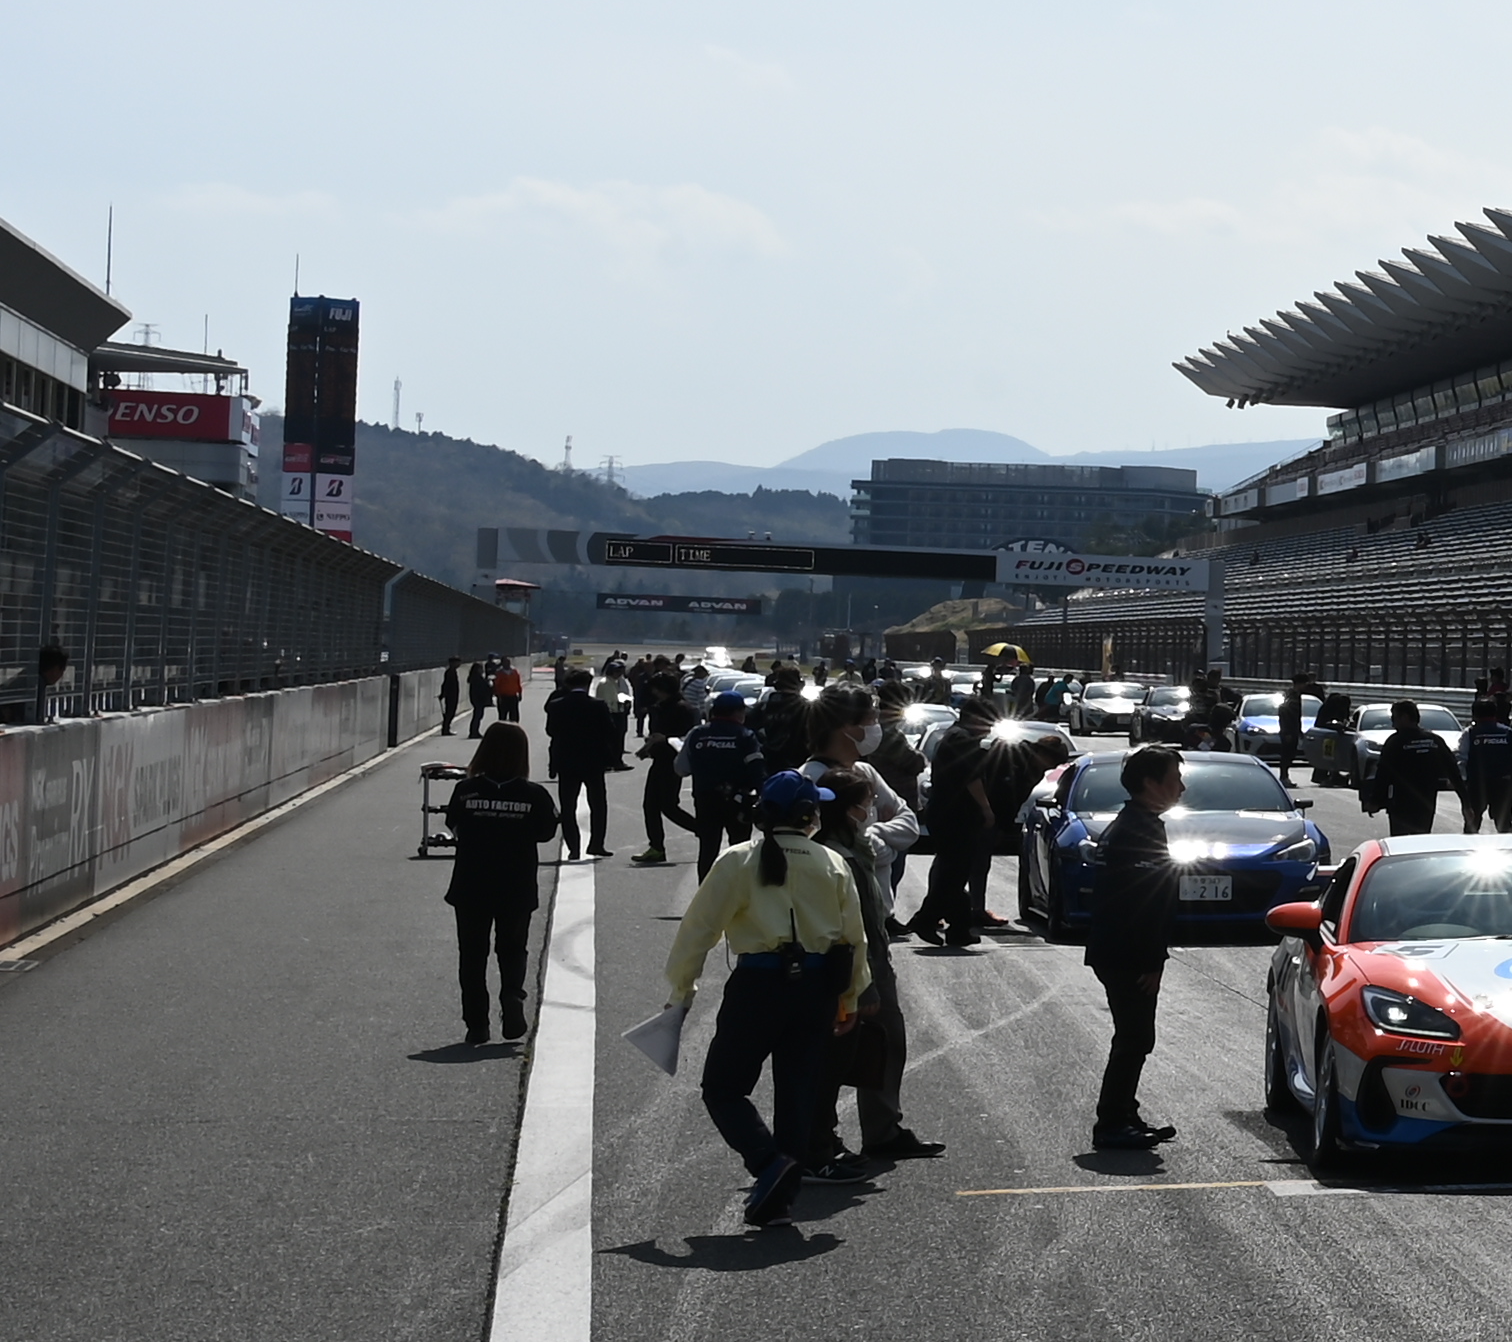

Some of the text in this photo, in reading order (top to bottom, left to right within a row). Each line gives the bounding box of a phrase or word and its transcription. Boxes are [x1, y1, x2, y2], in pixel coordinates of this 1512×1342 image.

[107, 401, 200, 425] ENSO
[609, 544, 634, 558] LAP
[680, 549, 711, 562] TIME
[1014, 558, 1192, 577] FUJI SPEEDWAY
[603, 596, 747, 611] ADVAN ADVAN
[465, 799, 532, 813] AUTO FACTORY
[1400, 1098, 1431, 1112] IDCC
